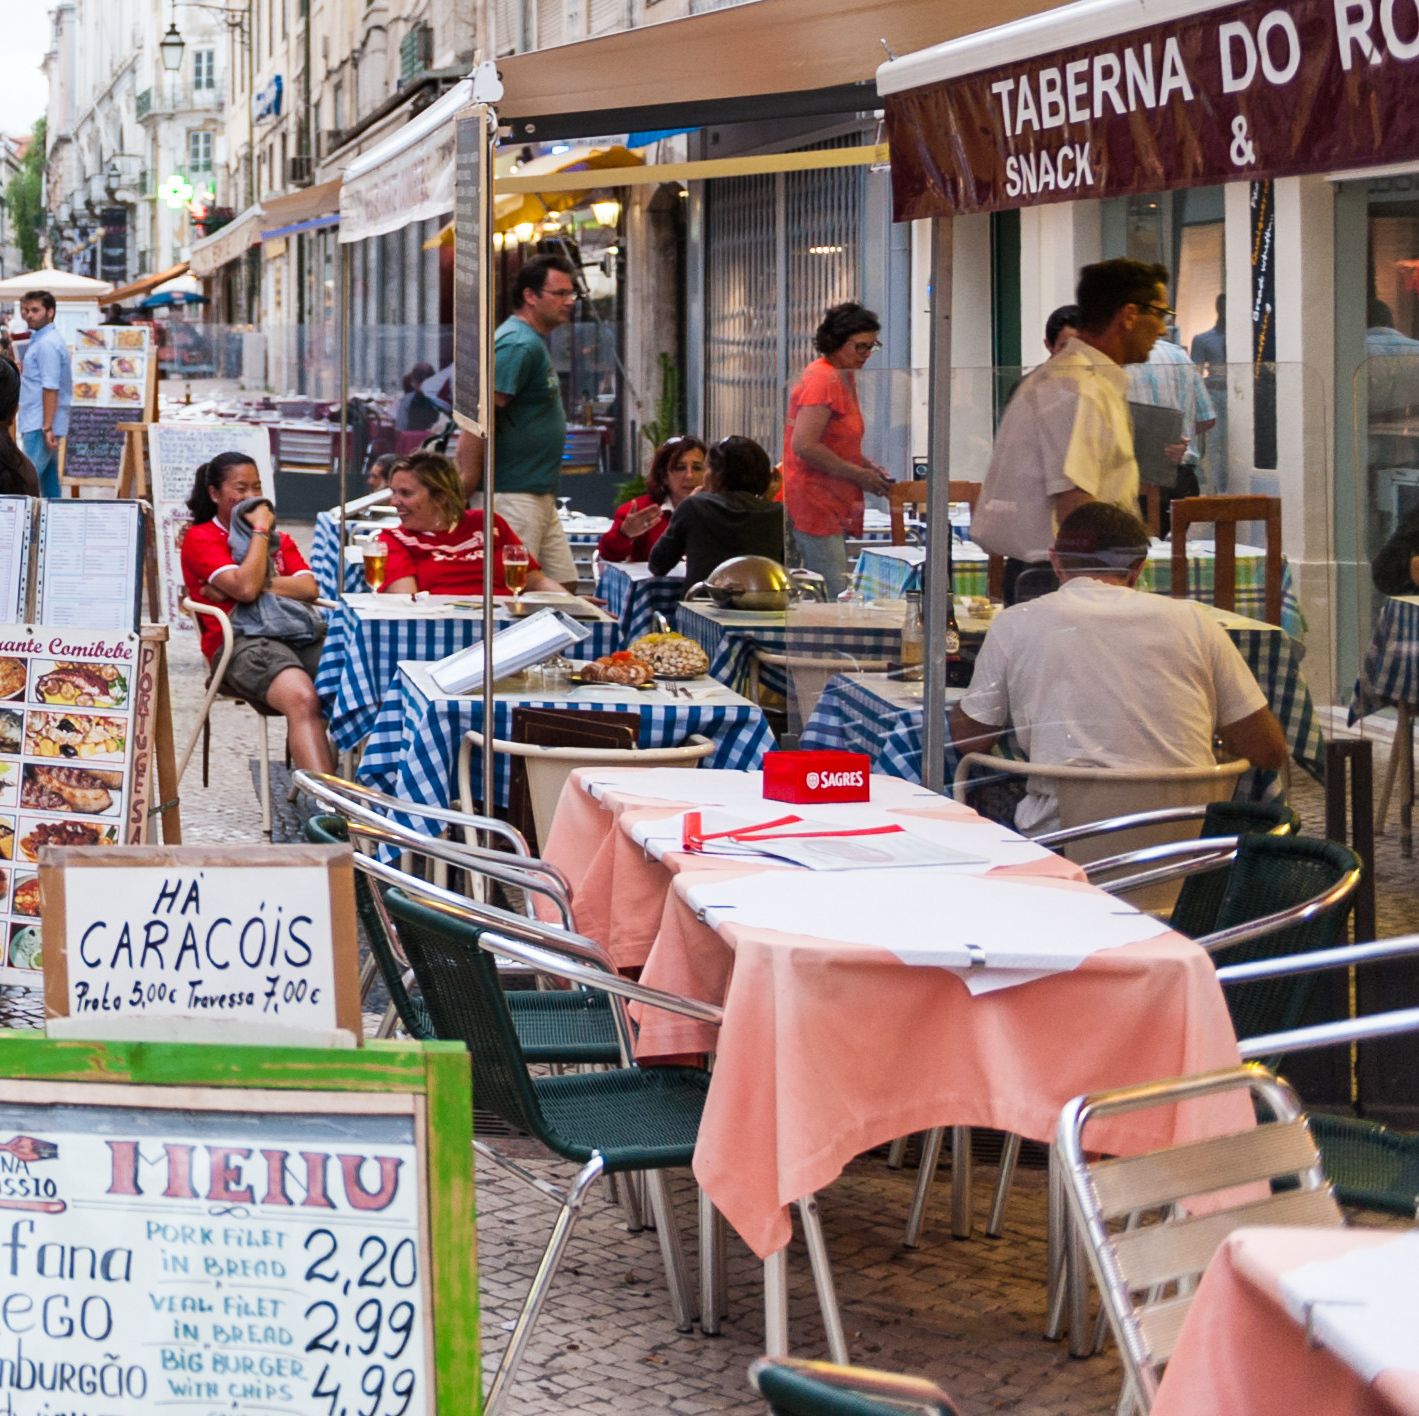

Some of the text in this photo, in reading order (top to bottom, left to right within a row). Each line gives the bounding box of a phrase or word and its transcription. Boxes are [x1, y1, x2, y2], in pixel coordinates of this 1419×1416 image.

[992, 36, 1194, 137] TABERNA
[1219, 9, 1302, 94] DO
[1006, 114, 1255, 198] SNACK &
[48, 638, 133, 660] Comibebe
[820, 771, 864, 789] SAGRES
[79, 901, 314, 972] CARACÓIS
[74, 981, 122, 1014] Prato
[103, 1140, 405, 1212] MENU
[146, 1220, 213, 1246] PORK
[304, 1228, 418, 1295] 2,20
[203, 1256, 287, 1279] BREAD
[148, 1293, 213, 1315] VEAL
[213, 1323, 295, 1348] BREAD
[212, 1352, 309, 1382] BURGER
